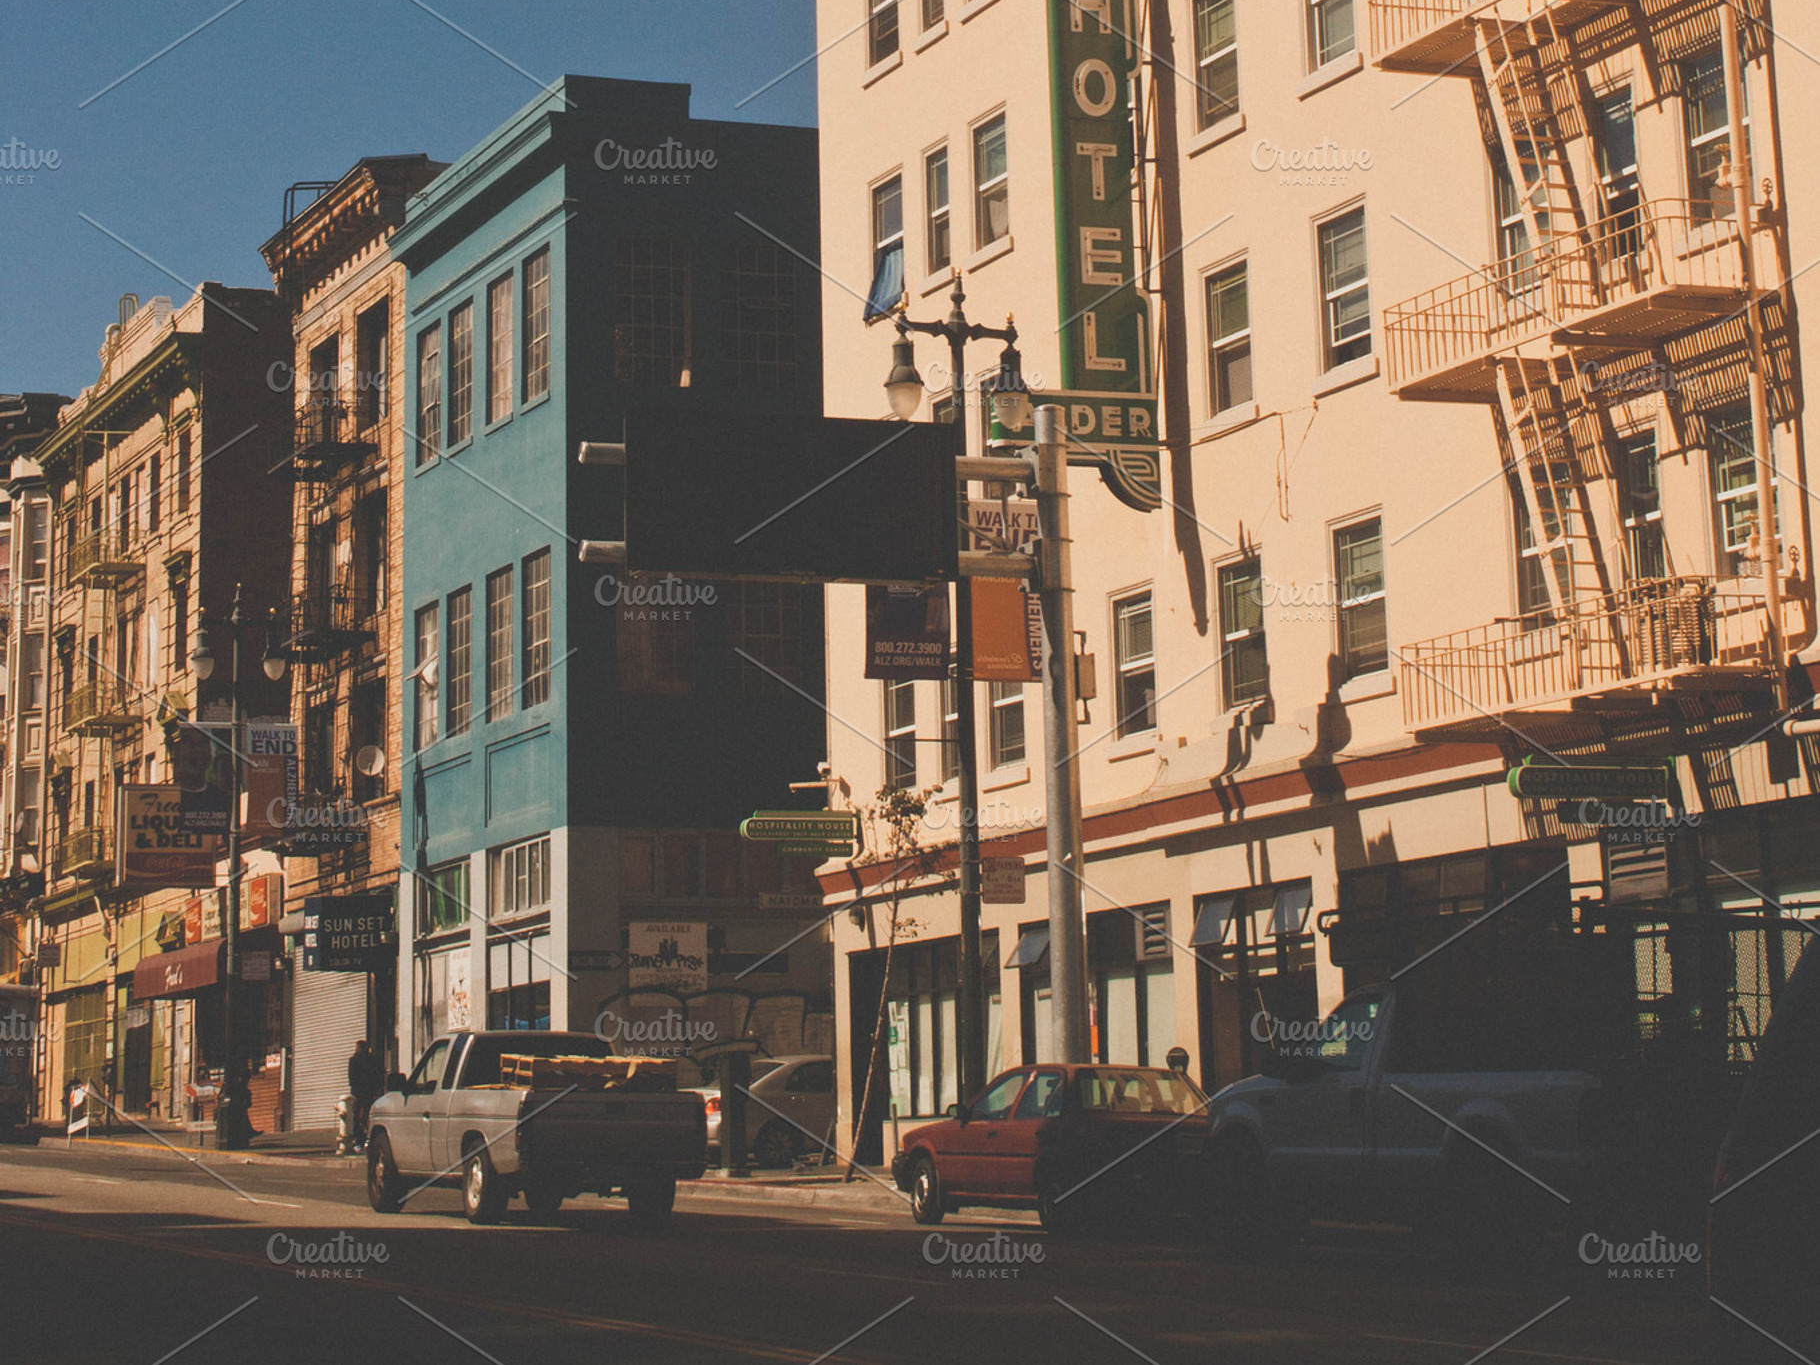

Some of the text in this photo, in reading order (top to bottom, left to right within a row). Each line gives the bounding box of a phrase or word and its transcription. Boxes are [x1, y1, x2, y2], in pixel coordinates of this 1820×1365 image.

[1012, 402, 1153, 438] DER
[976, 510, 1021, 528] WAK
[874, 641, 942, 654] 800.272.3900
[251, 730, 296, 740] WALK TO
[252, 740, 297, 754] END
[131, 815, 180, 832] LIQU
[749, 821, 851, 831] HOSPITALITY HOUSE
[157, 833, 203, 848] DELI
[646, 924, 691, 932] AVAILABLE
[331, 934, 378, 949] HOTEL
